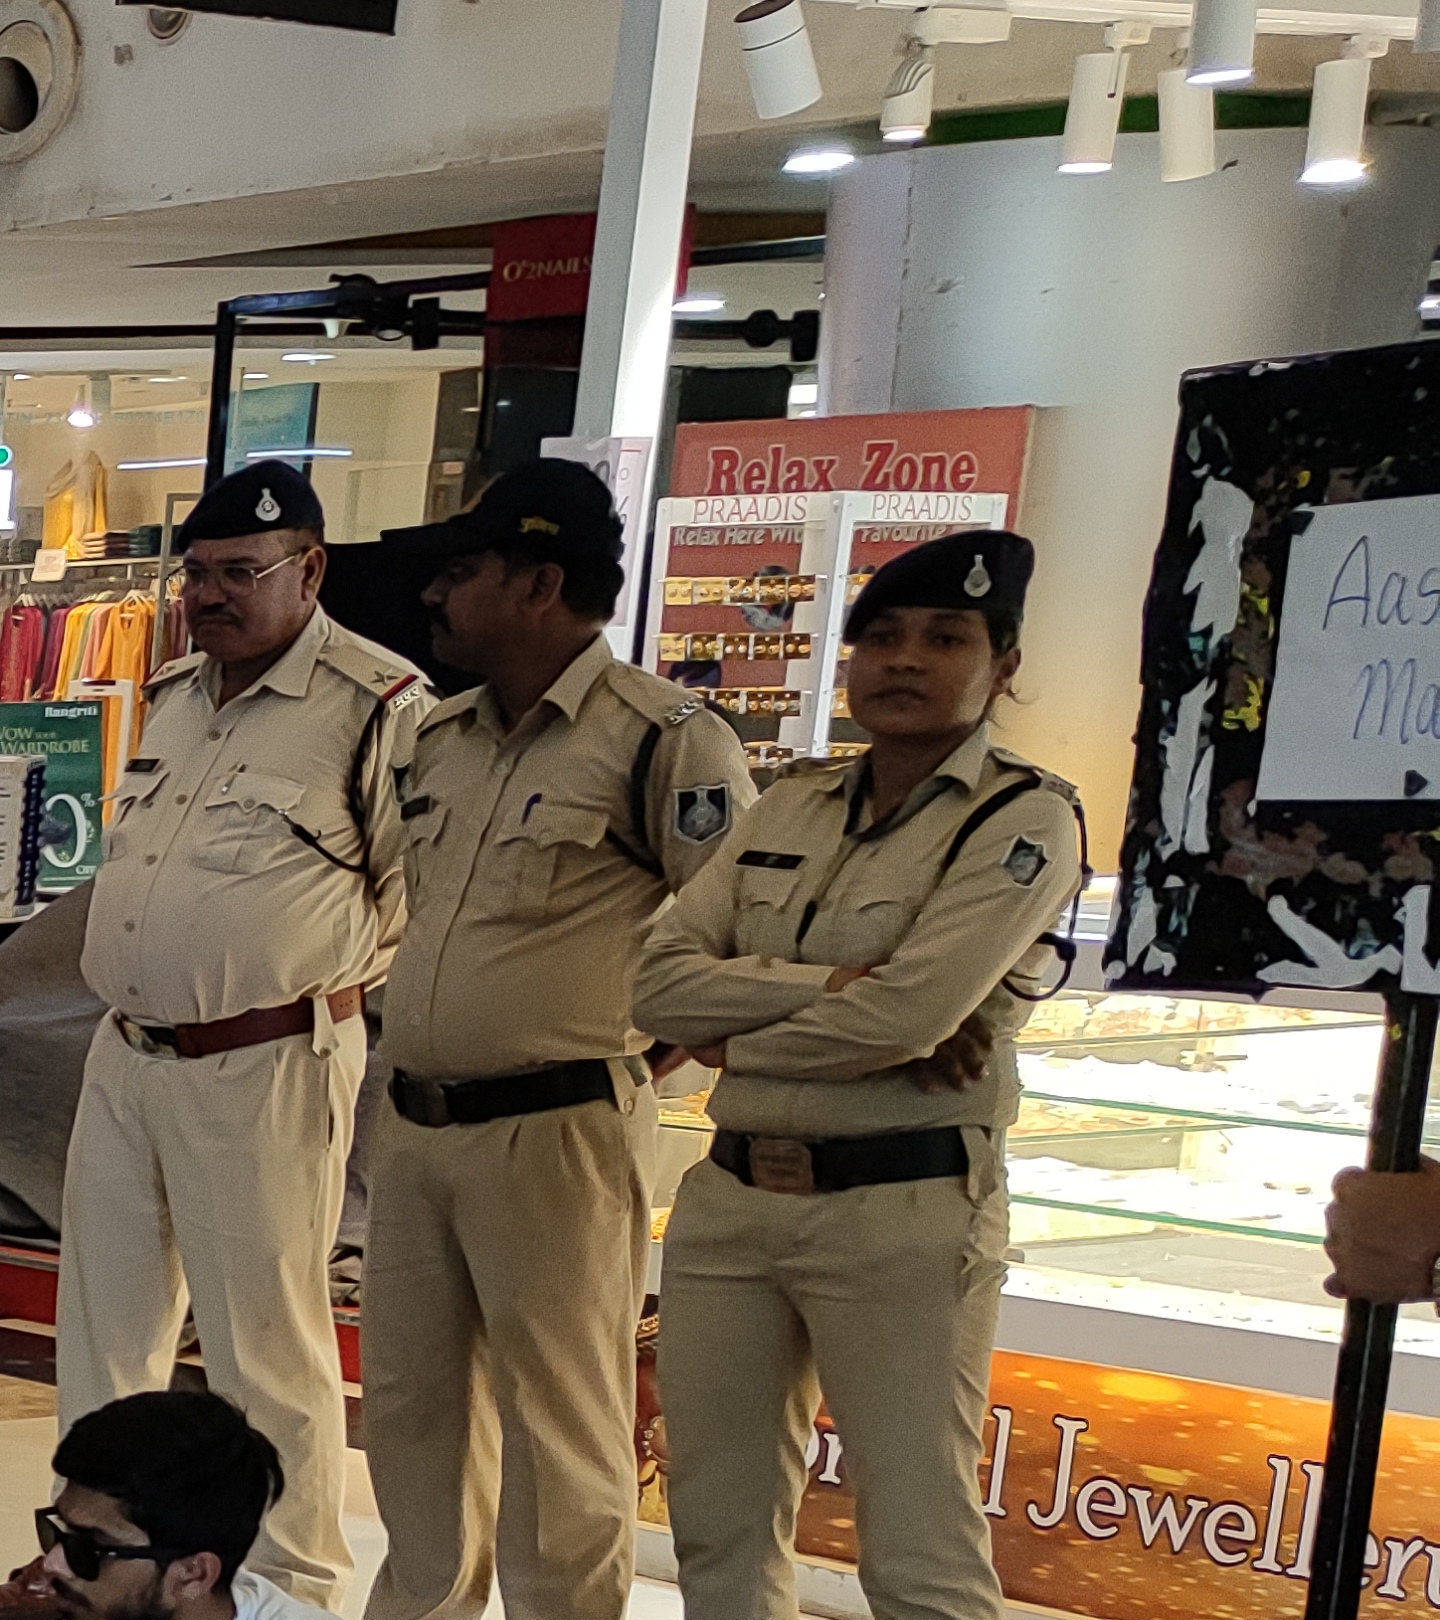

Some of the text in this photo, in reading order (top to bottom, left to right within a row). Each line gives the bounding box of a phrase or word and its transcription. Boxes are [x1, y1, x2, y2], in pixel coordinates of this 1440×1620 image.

[704, 439, 978, 494] Relax Zone
[693, 496, 807, 524] PRAADIS
[871, 494, 972, 521] PRAADIS
